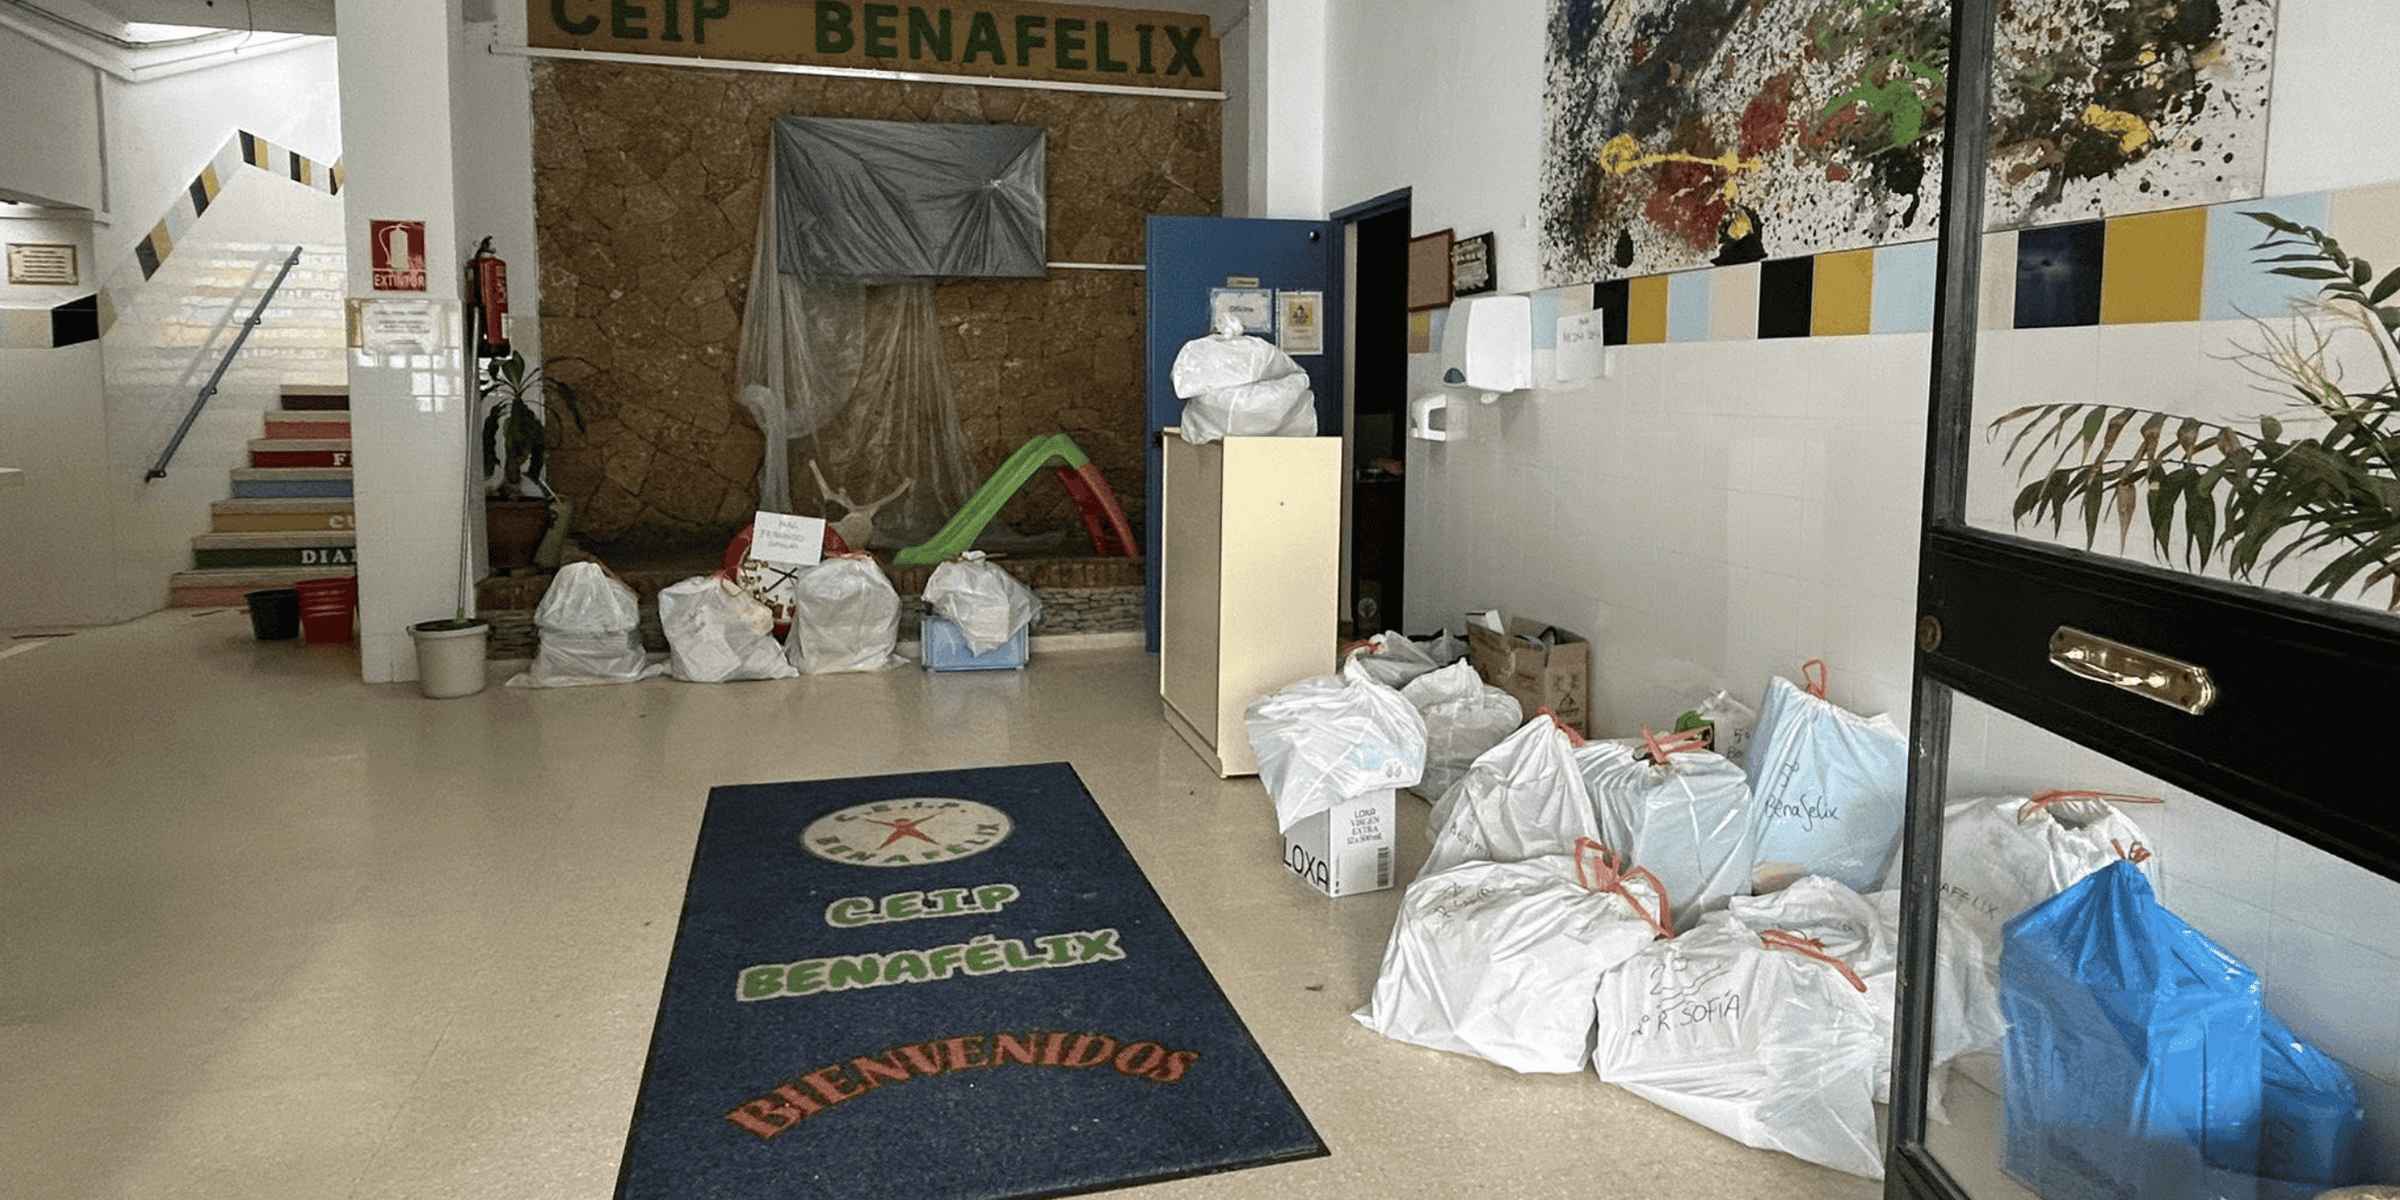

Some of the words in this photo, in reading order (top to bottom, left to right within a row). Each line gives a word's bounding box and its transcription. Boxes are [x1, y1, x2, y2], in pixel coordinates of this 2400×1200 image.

[551, 0, 730, 43] CEIP
[815, 1, 1206, 77] BENAFELIX
[374, 274, 425, 288] EXTINTOR
[1352, 826, 1379, 836] EXTRA
[1283, 836, 1328, 892] LOXA
[736, 929, 1127, 1001] BENAFÉLIX
[726, 1031, 1199, 1140] BIENVENIDOS
